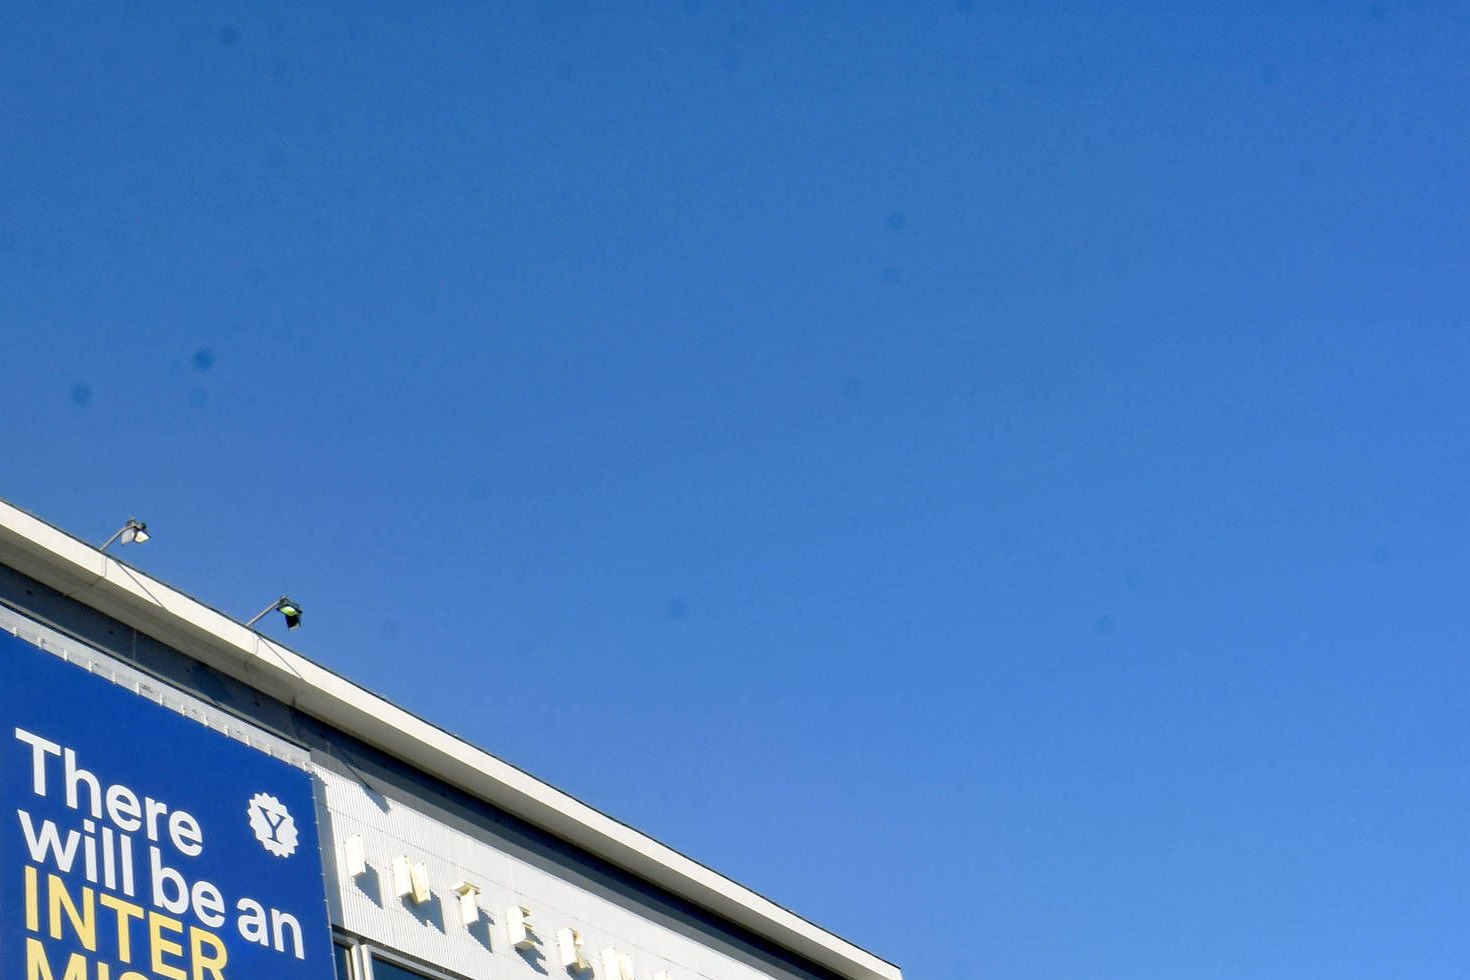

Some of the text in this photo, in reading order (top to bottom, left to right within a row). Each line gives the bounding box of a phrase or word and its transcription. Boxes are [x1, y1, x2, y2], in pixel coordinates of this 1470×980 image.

[15, 727, 203, 857] There
[17, 809, 305, 961] will be an
